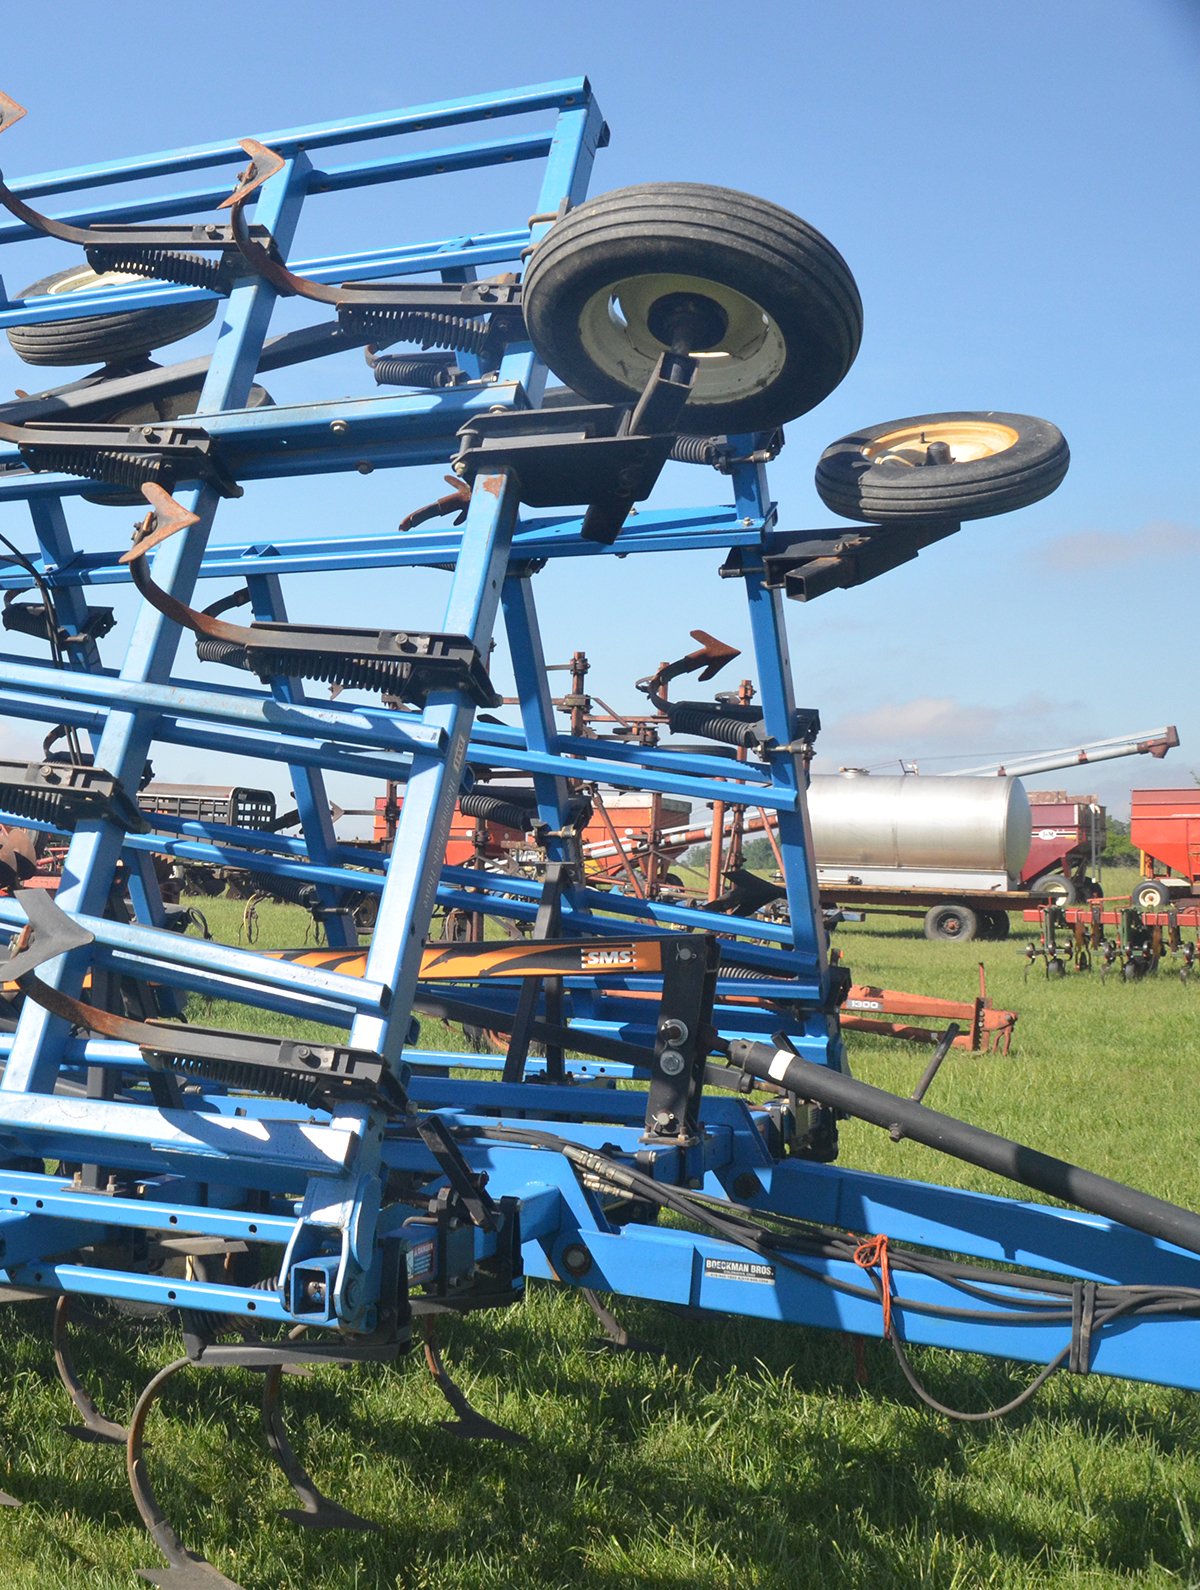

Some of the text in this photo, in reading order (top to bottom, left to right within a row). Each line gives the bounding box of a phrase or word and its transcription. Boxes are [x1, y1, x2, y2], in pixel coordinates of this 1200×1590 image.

[587, 951, 631, 964] SMS
[851, 1000, 879, 1009] 1300
[706, 1259, 749, 1273] BOECKMAN
[750, 1265, 774, 1276] BROS.
